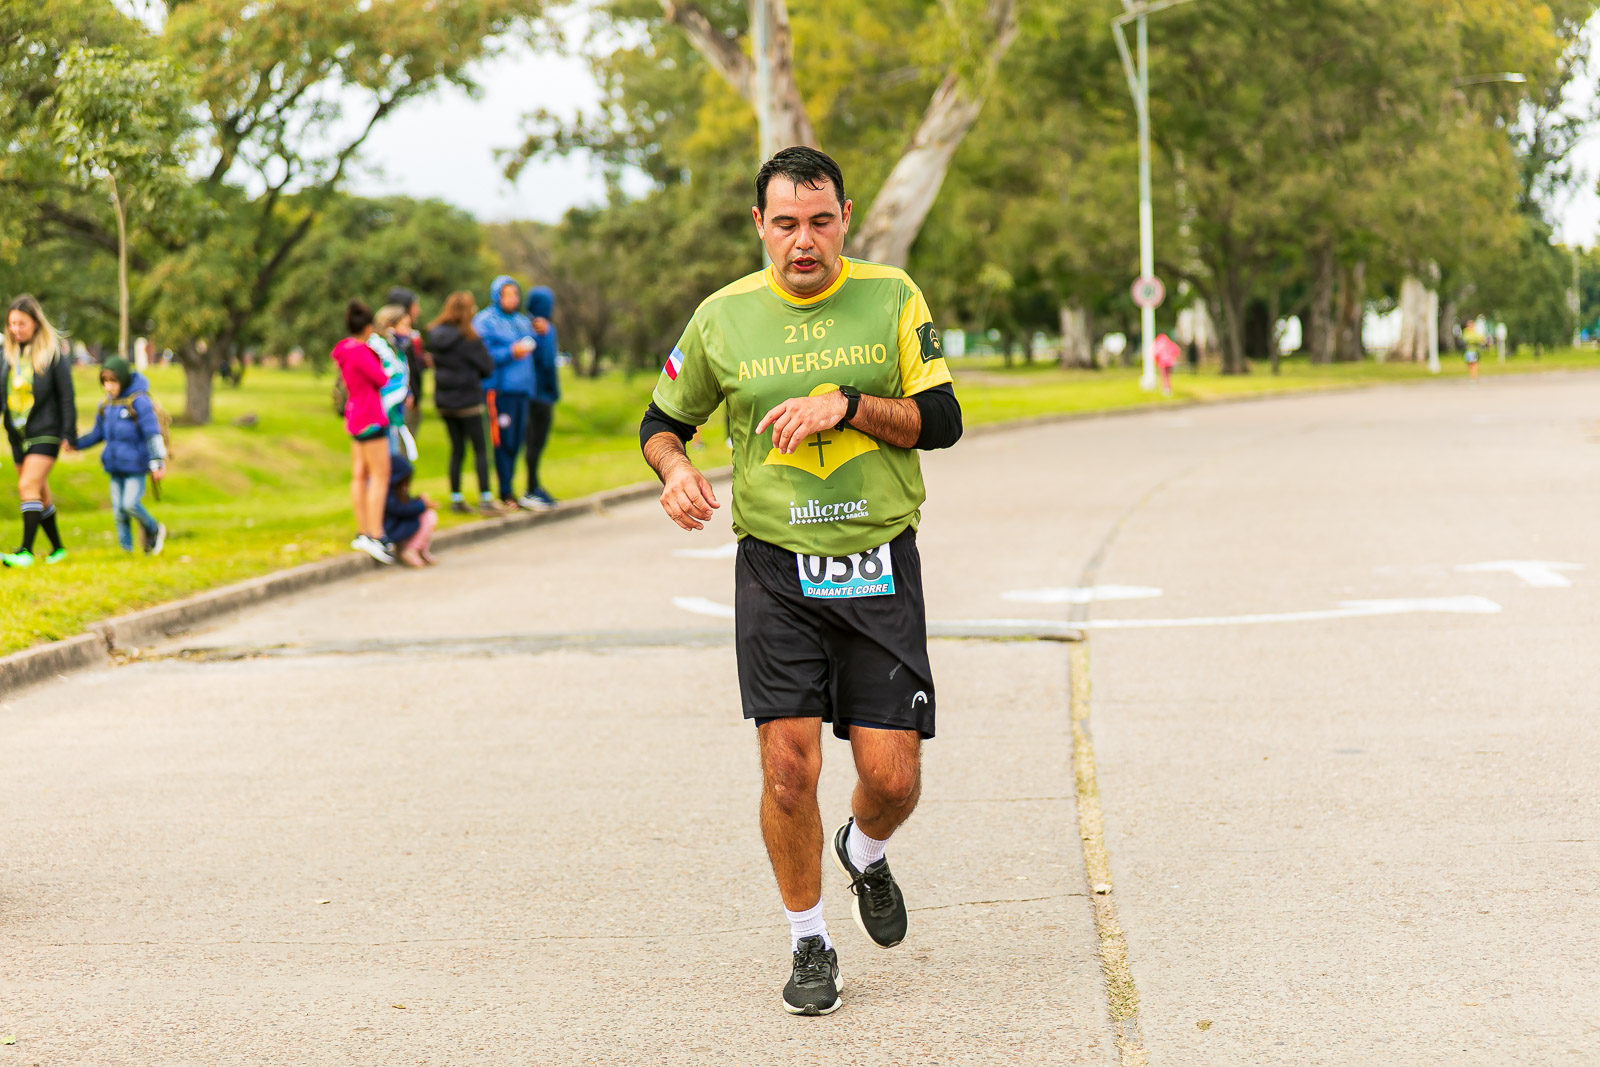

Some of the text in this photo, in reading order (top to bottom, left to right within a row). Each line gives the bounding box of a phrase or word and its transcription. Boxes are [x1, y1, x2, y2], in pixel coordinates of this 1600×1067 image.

[784, 318, 835, 344] 216°
[738, 343, 887, 382] ANIVERSARIO
[788, 499, 868, 525] julicroc
[845, 510, 869, 519] snacks
[807, 583, 889, 596] DIAMANTE CORRE
